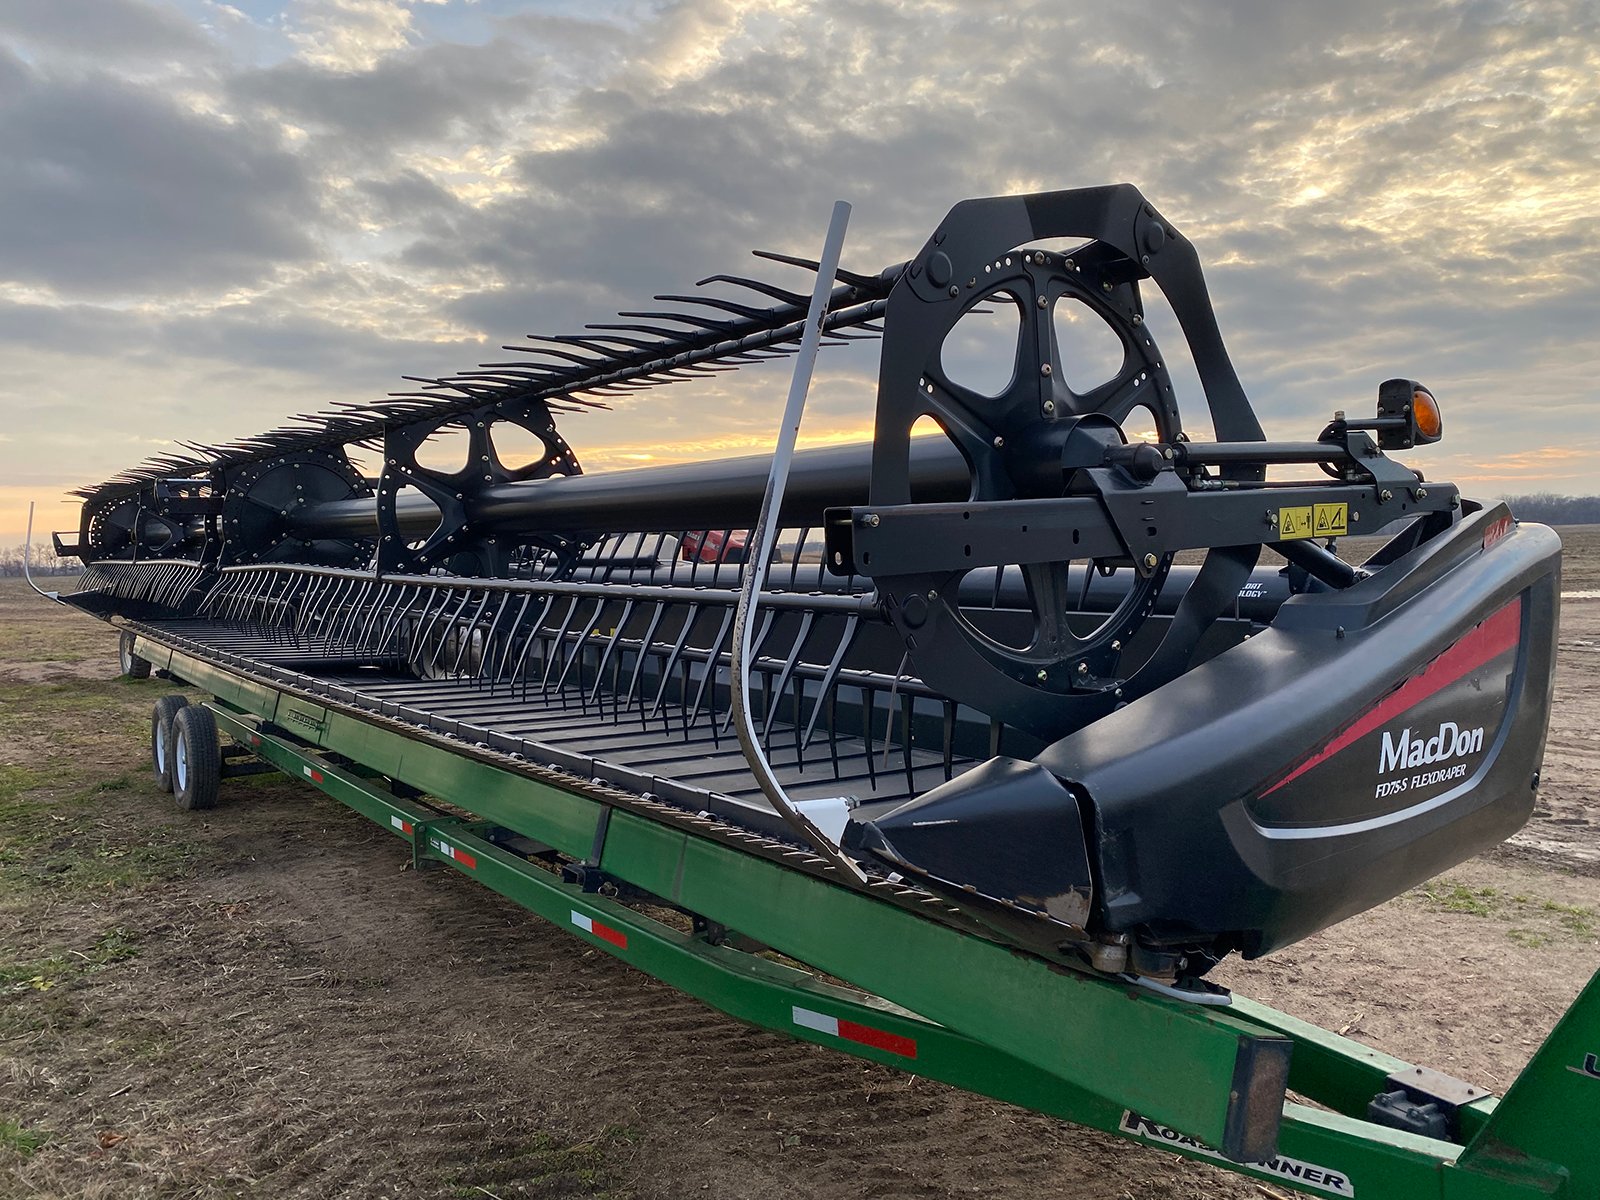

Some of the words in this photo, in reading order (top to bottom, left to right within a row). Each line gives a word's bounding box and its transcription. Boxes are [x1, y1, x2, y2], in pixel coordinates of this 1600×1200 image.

[1379, 722, 1484, 774] MacDon
[1375, 778, 1408, 798] FD75-S
[1411, 764, 1467, 789] FLEXDRAPER
